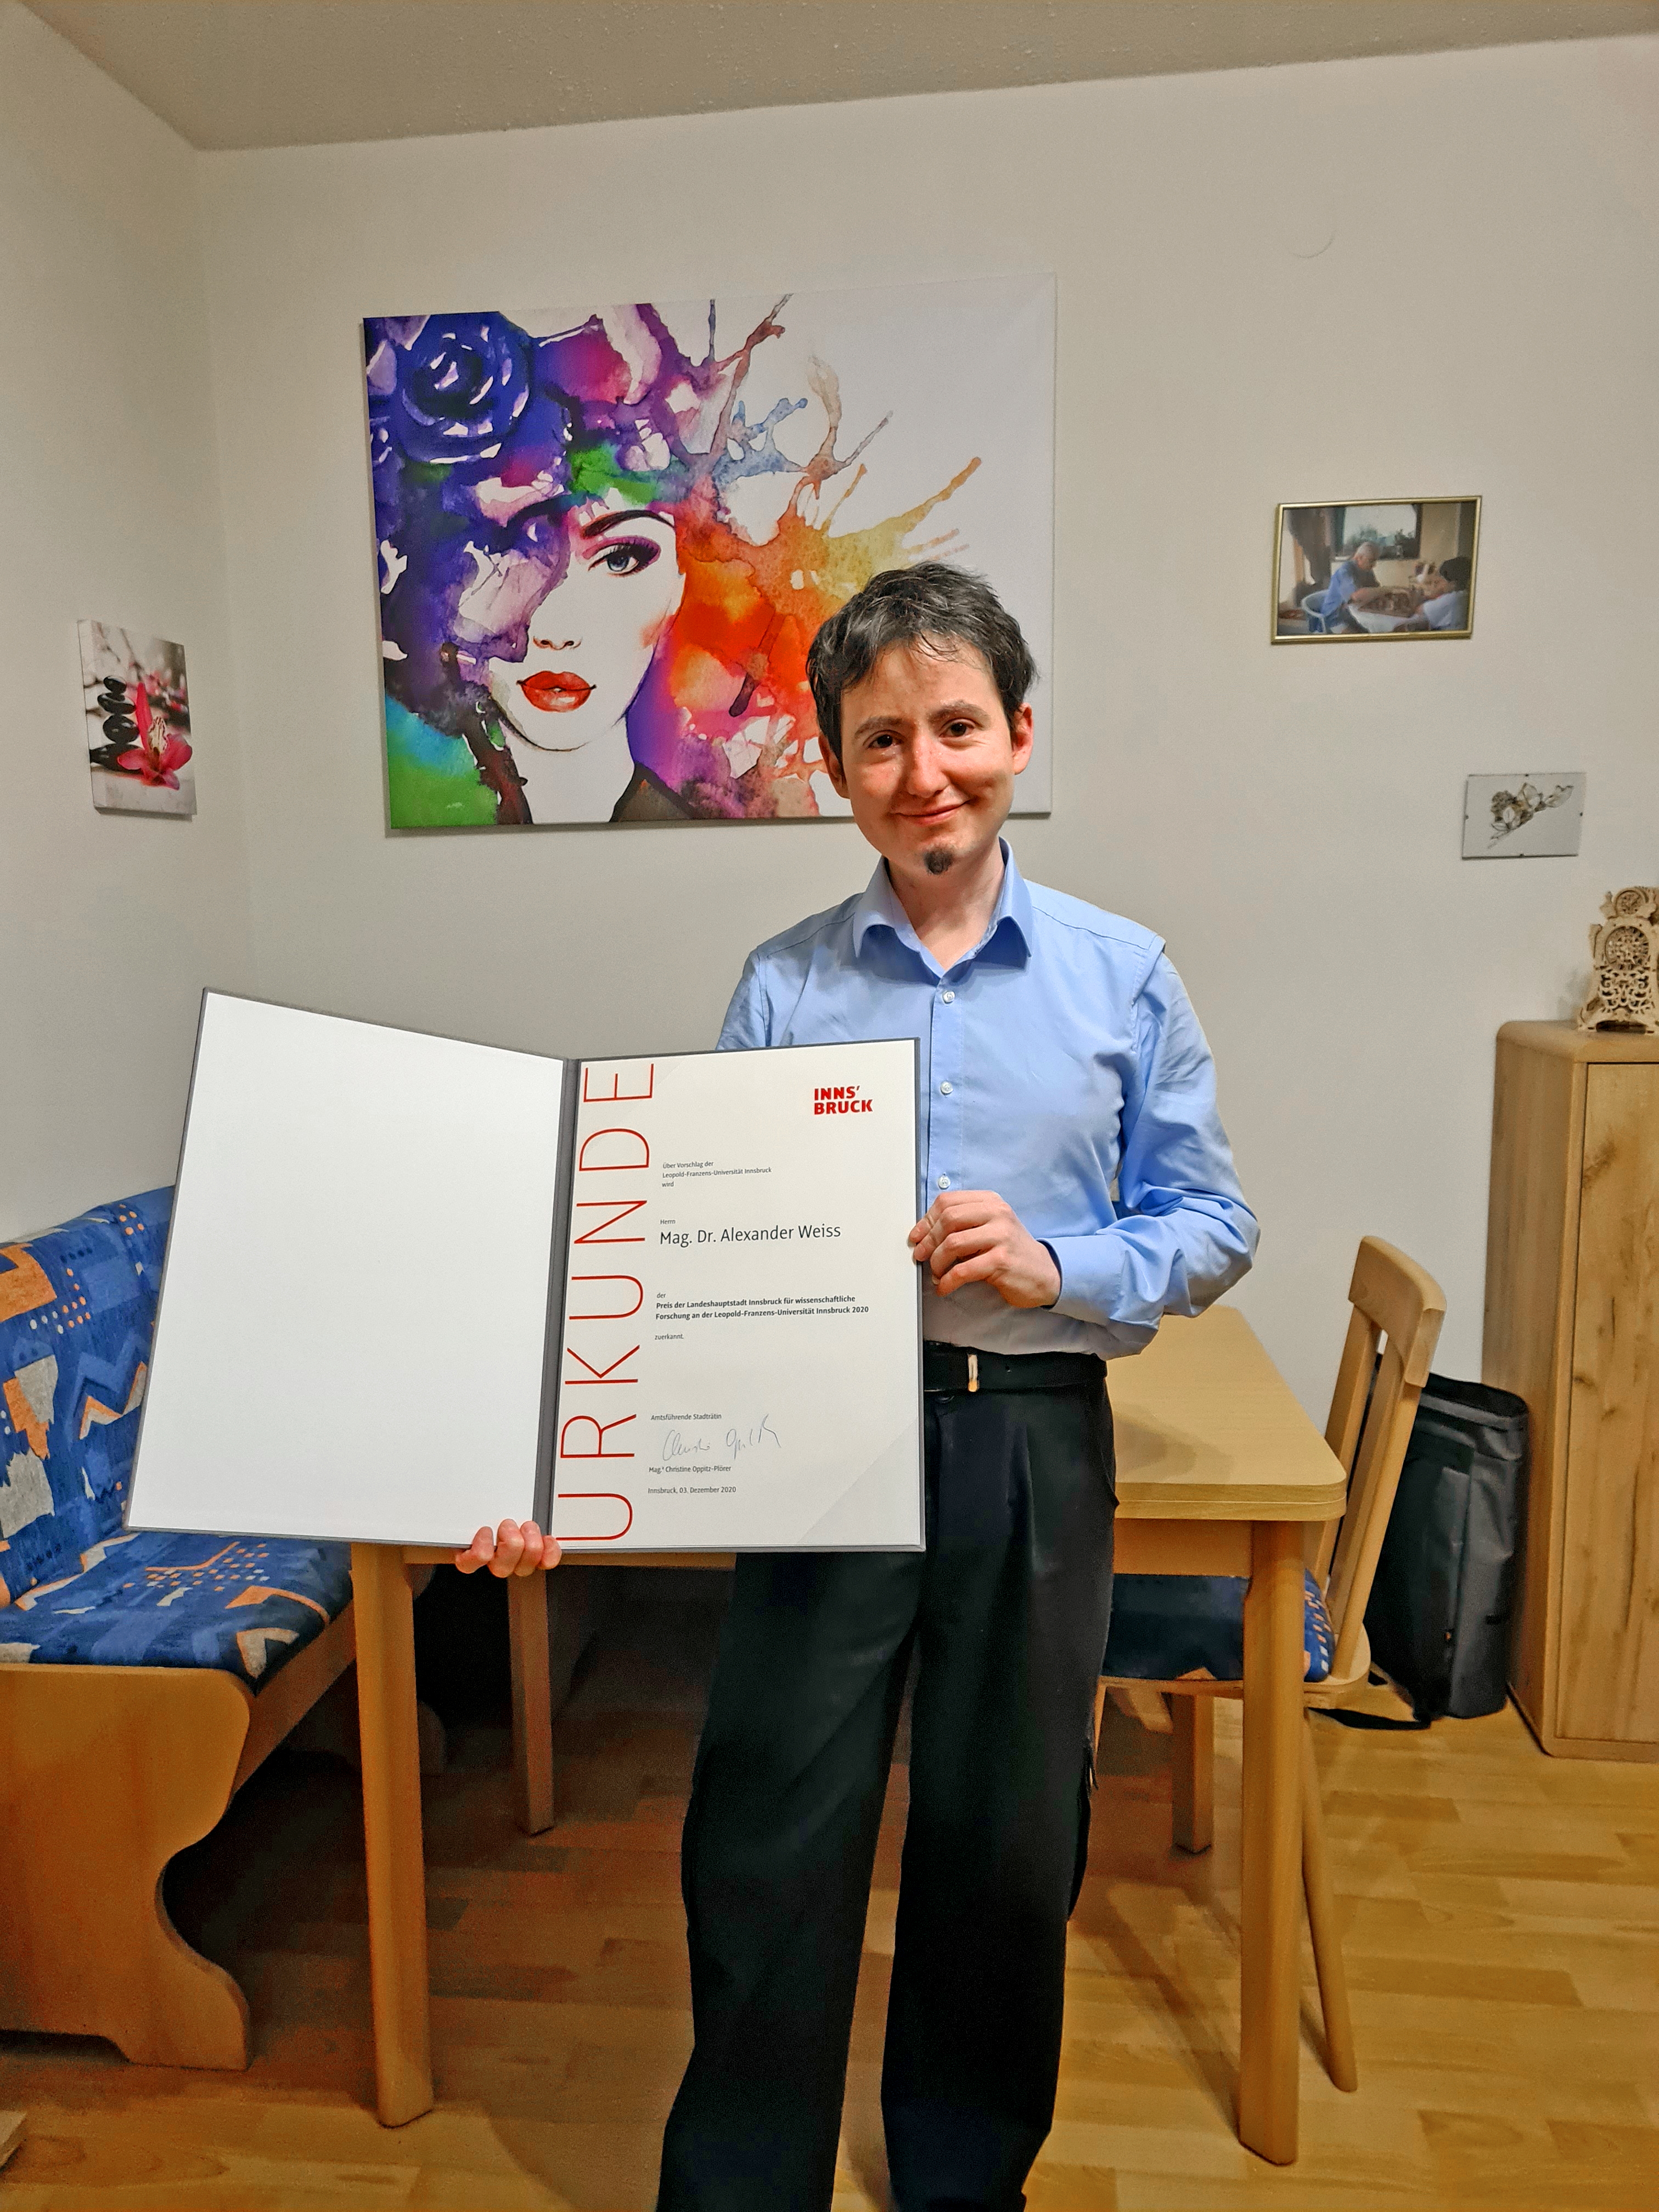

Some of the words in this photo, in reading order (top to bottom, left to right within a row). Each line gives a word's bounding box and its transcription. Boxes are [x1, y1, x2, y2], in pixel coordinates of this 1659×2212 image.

[814, 1099, 873, 1115] BRUCK
[662, 1168, 743, 1179] Leopold-Franzens-Universität
[660, 1231, 692, 1248] Mag.
[698, 1230, 716, 1243] Dr.
[721, 1225, 794, 1242] Alexander
[798, 1224, 841, 1239] Weiss
[556, 1063, 654, 1541] URKUNDE
[687, 1299, 747, 1308] Landeshauptstadt
[795, 1295, 855, 1304] wissenschaftliche
[715, 1307, 814, 1319] Leopold-Franzens-Universität
[693, 1465, 731, 1473] Oppitz-Plörer
